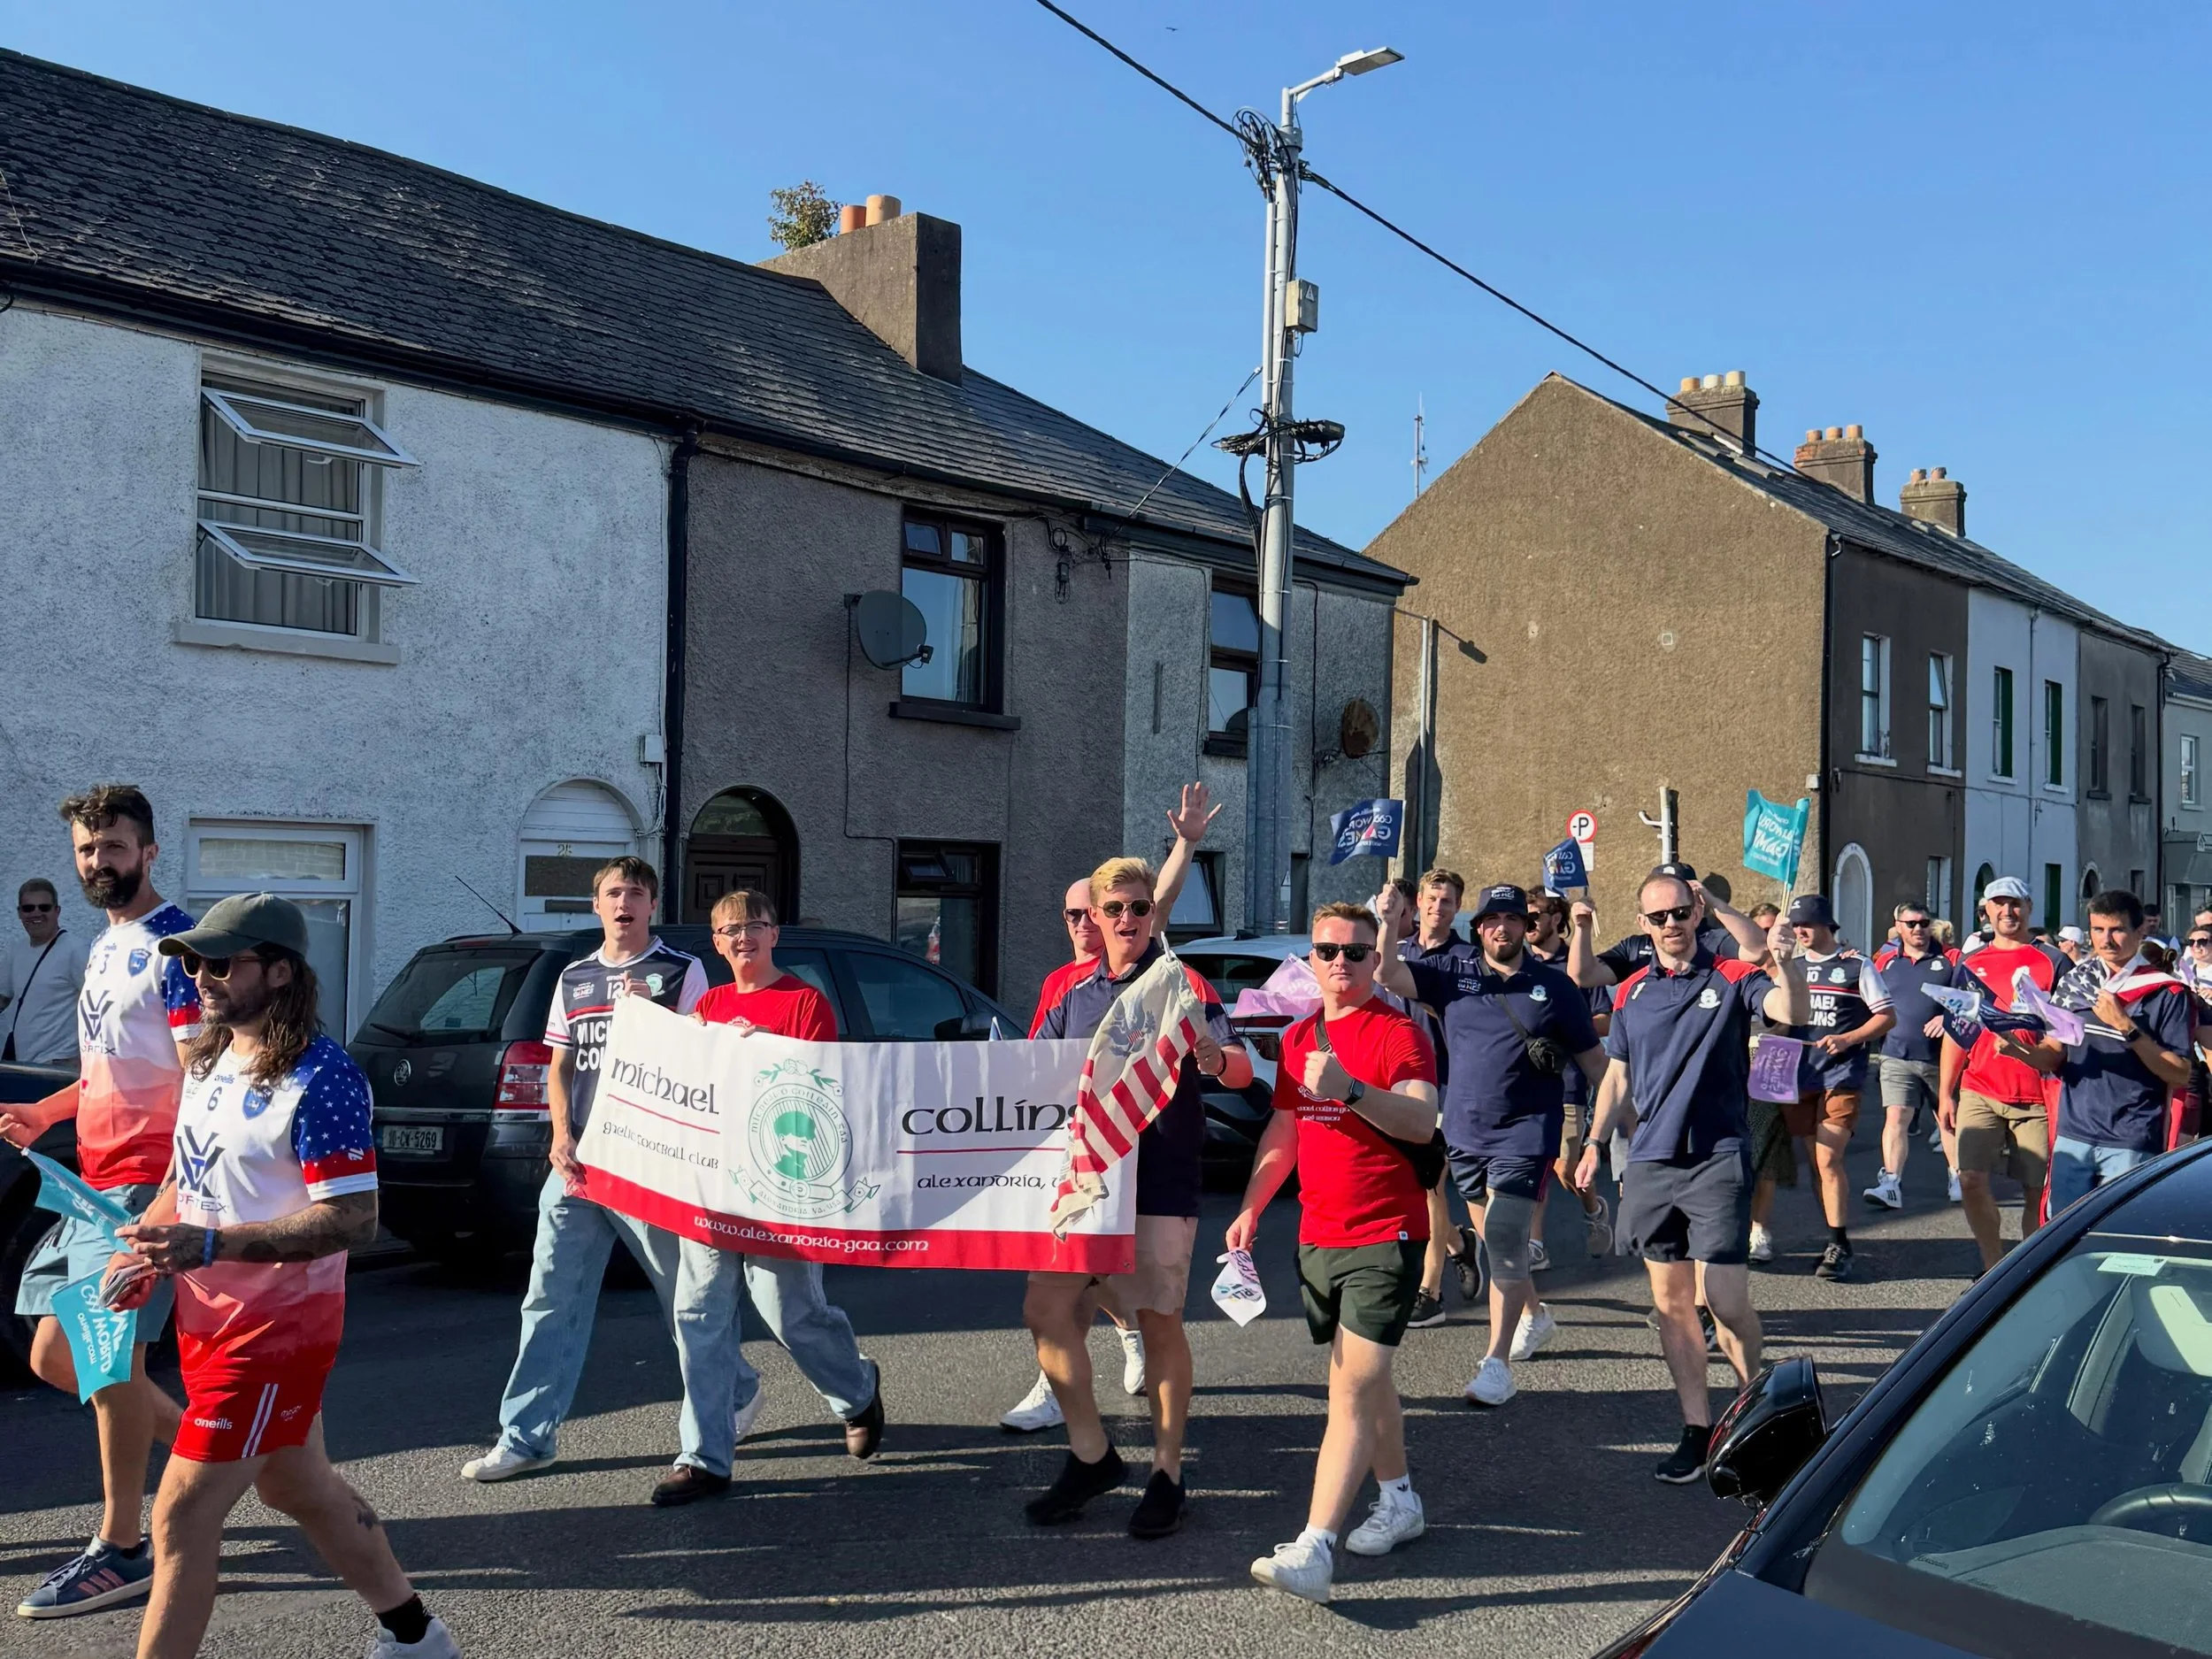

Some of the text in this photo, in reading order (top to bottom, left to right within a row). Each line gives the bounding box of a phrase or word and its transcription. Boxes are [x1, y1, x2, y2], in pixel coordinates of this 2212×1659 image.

[207, 1086, 223, 1111] 6
[694, 1215, 929, 1253] www.alexandria-gaa.com
[194, 1417, 234, 1430] oneills
